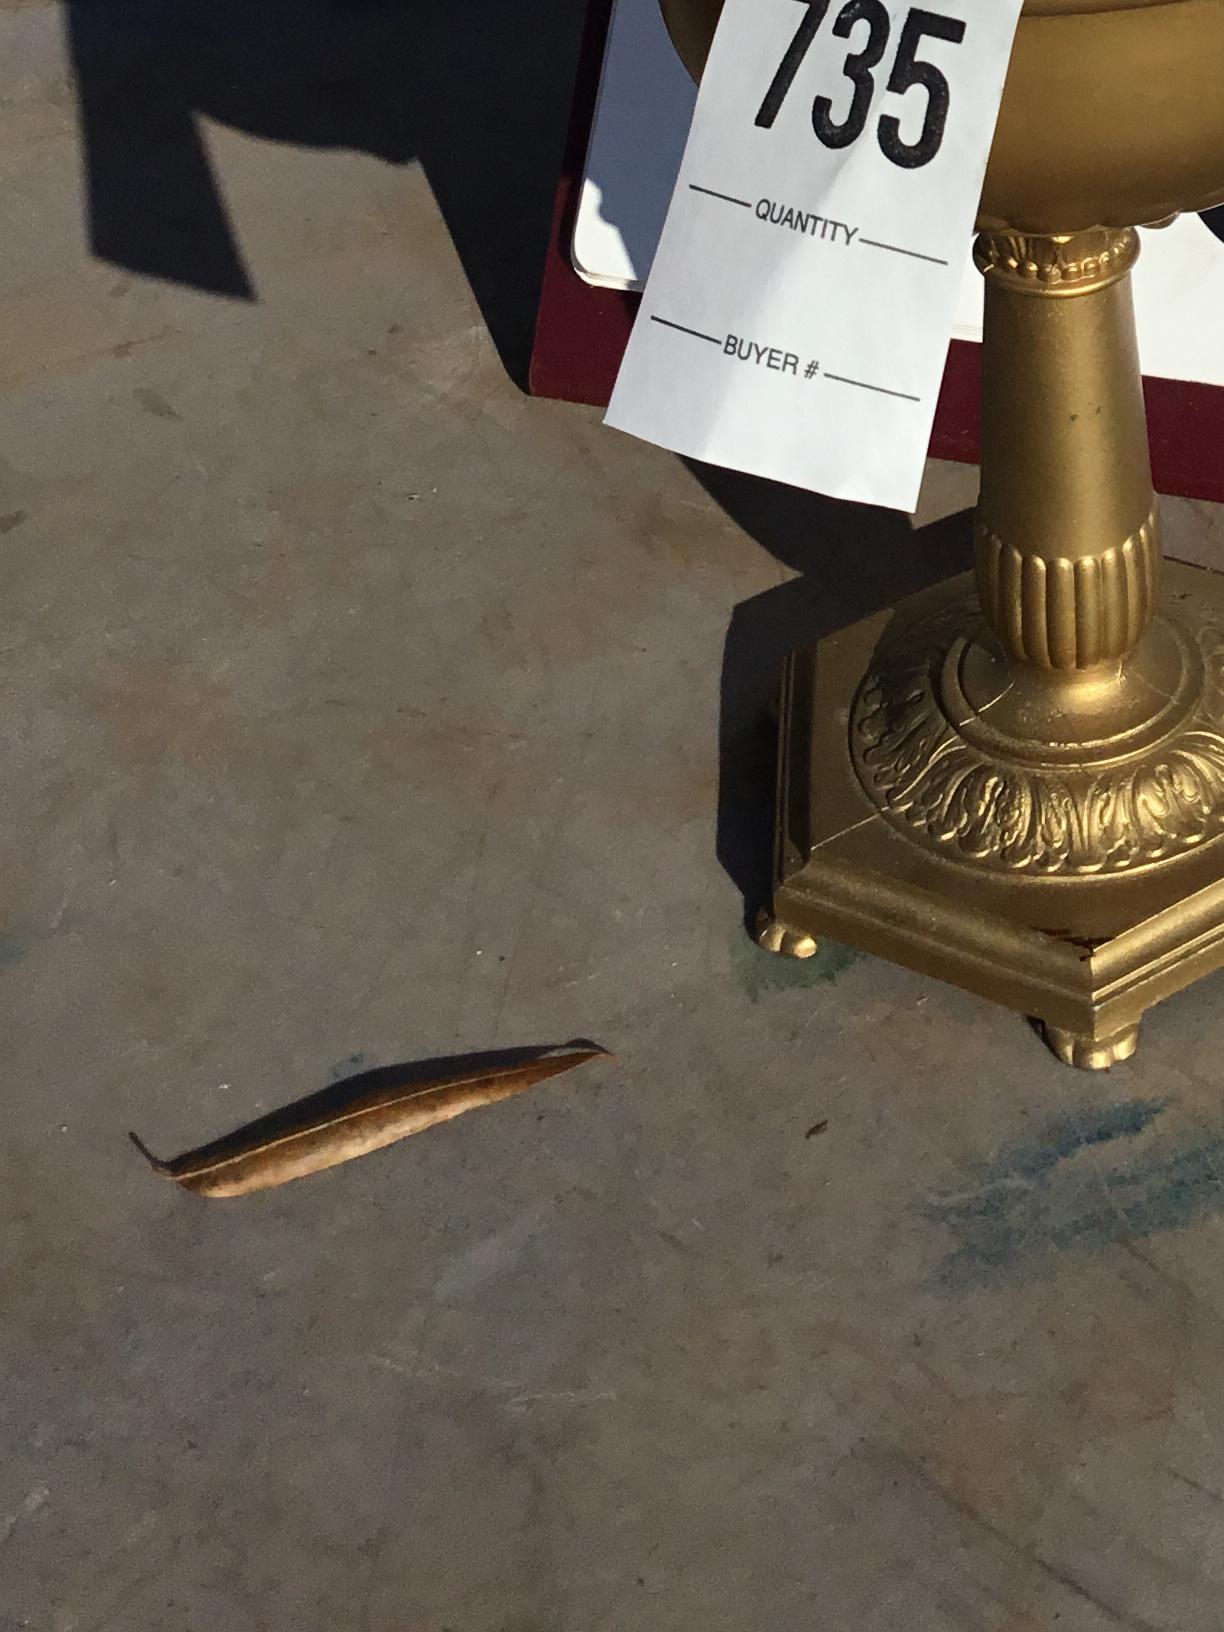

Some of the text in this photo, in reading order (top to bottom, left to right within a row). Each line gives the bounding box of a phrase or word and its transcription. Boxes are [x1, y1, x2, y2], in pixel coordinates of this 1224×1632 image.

[755, 198, 860, 247] QUANTITY
[723, 334, 820, 379] BUYER #
